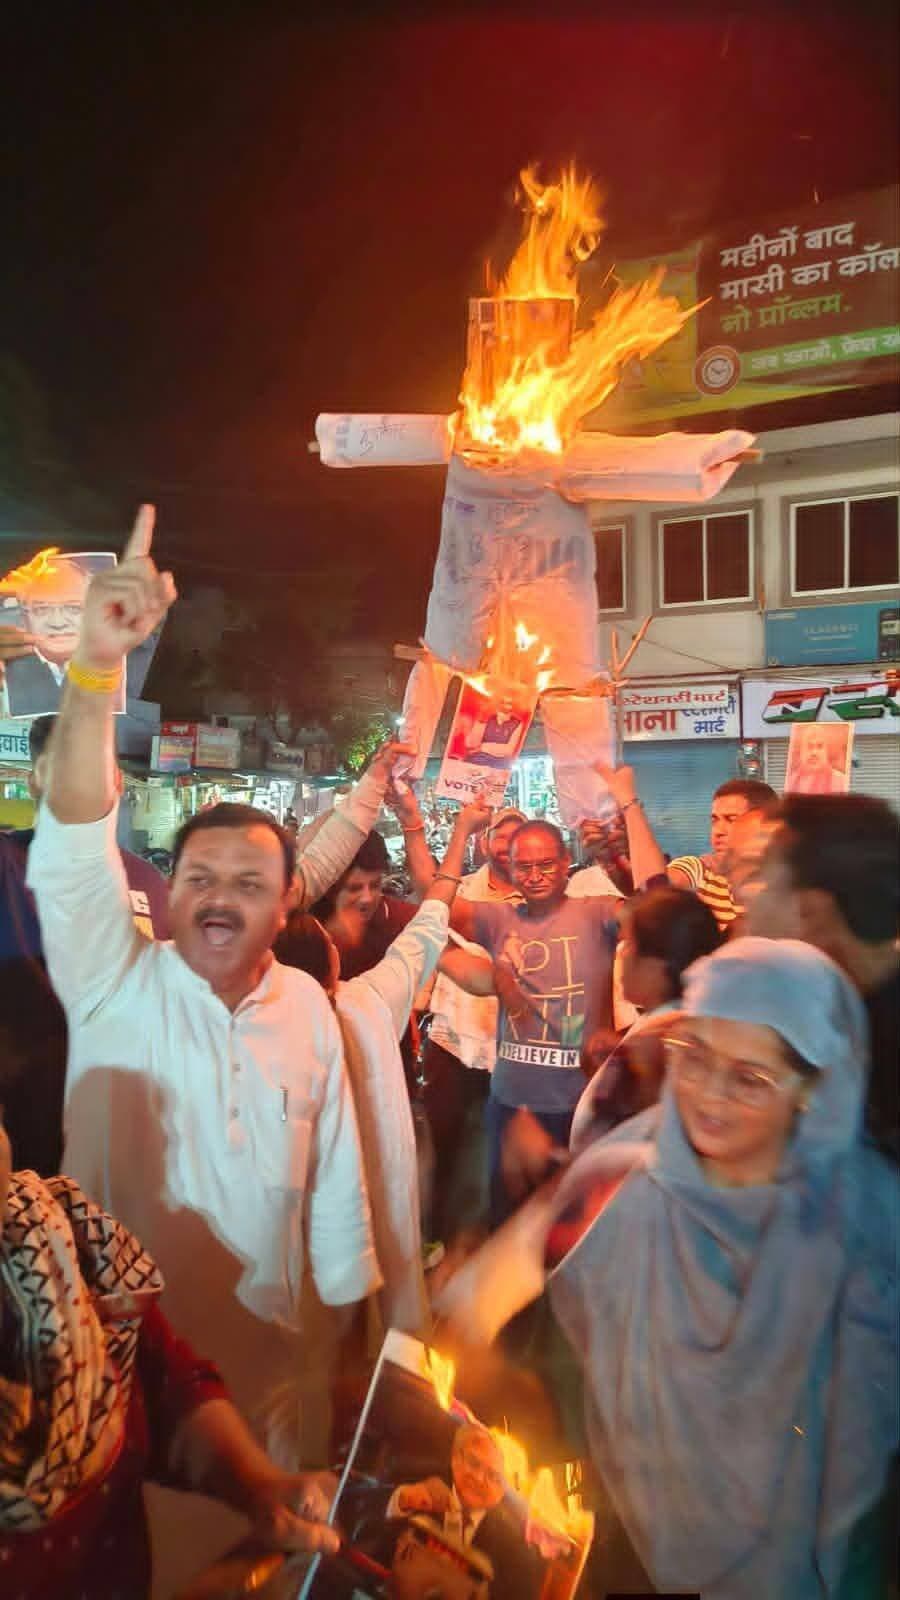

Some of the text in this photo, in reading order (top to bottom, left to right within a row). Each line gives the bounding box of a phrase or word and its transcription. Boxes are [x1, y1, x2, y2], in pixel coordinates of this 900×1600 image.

[720, 222, 855, 267] महीनों बाद
[720, 263, 784, 299] मासी
[791, 261, 832, 285] का
[720, 305, 752, 334] नो
[694, 716, 727, 733] मार्ट
[444, 779, 479, 793] VOTE
[560, 1051, 577, 1066] IN
